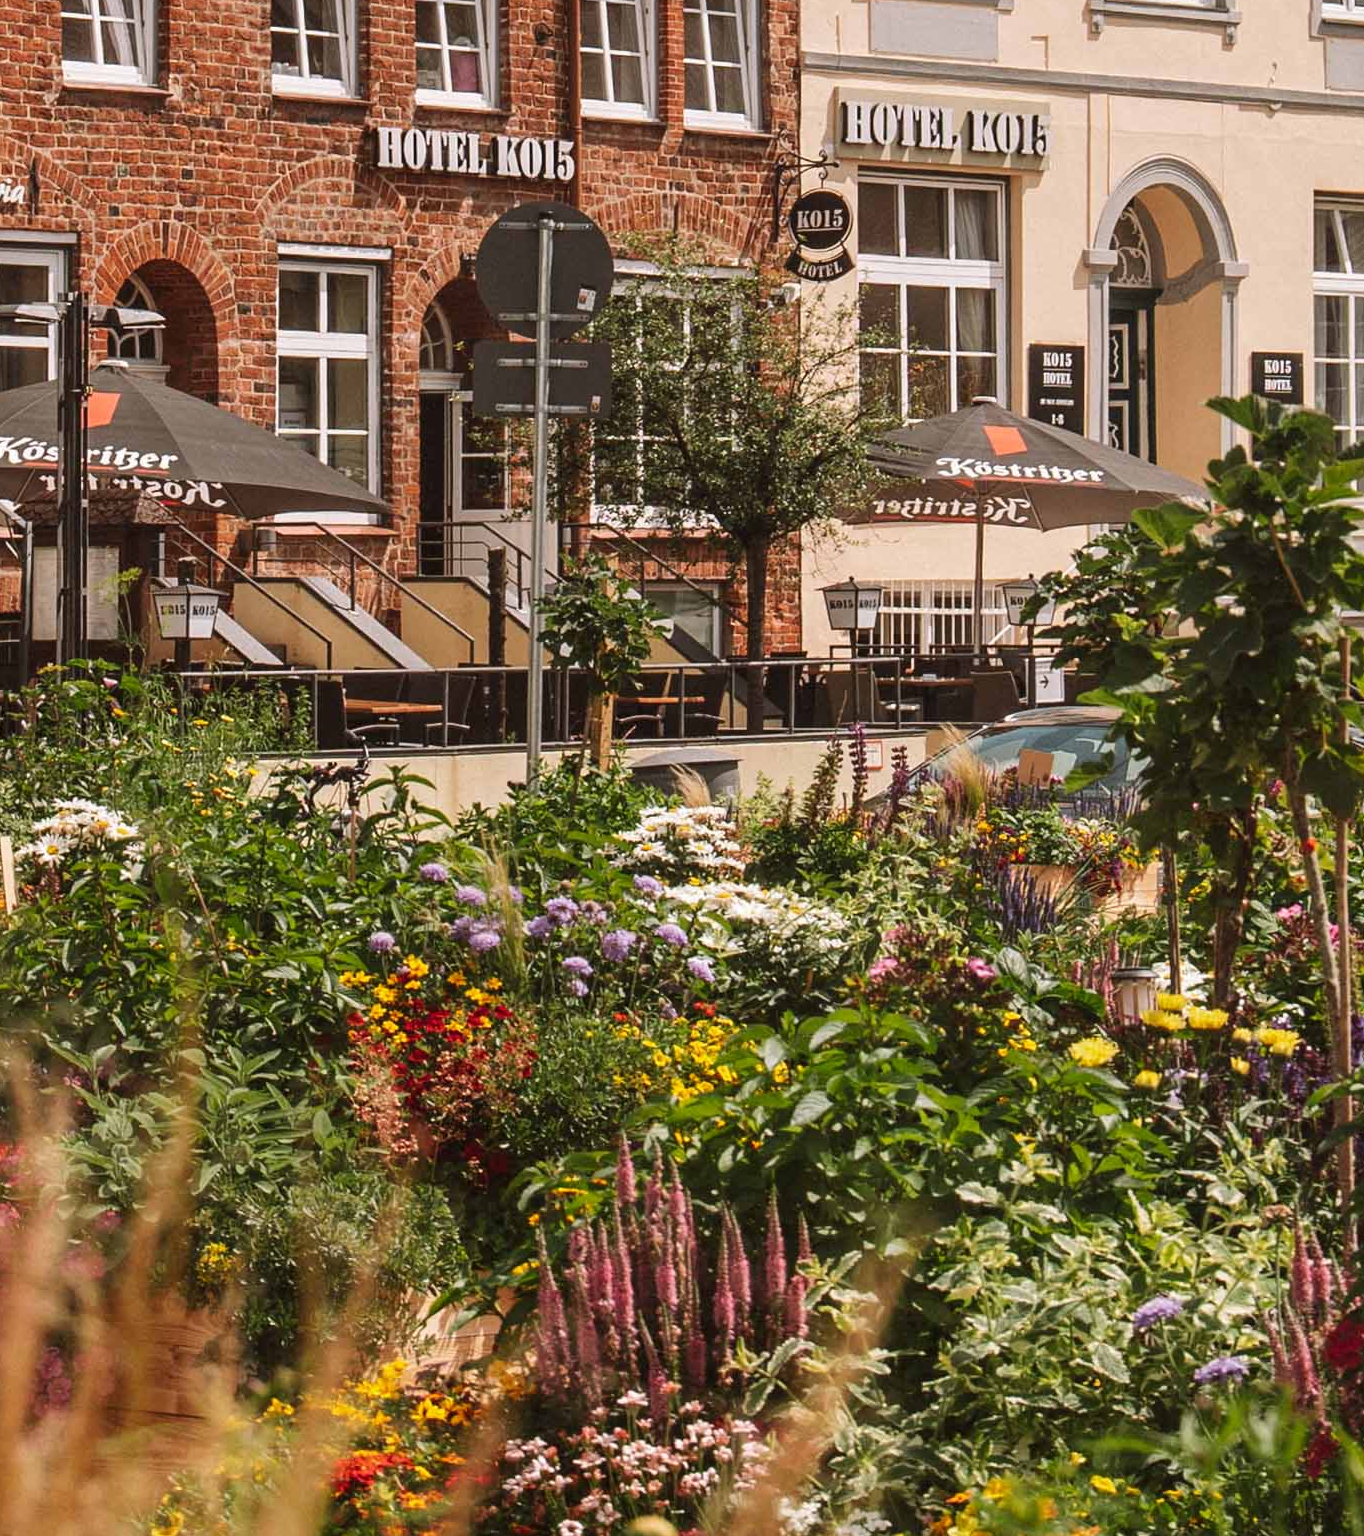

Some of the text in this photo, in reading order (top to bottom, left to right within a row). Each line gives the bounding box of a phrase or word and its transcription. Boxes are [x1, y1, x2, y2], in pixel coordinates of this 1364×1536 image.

[845, 99, 1052, 156] HOTEL KO15
[377, 127, 576, 181] HOTEL KO15
[797, 209, 844, 229] KO15
[797, 260, 843, 278] HOTEL
[1042, 352, 1073, 368] KO15
[1264, 359, 1292, 374] KO15
[1042, 372, 1073, 385] HOTEL
[936, 457, 1105, 483] Köstritzer
